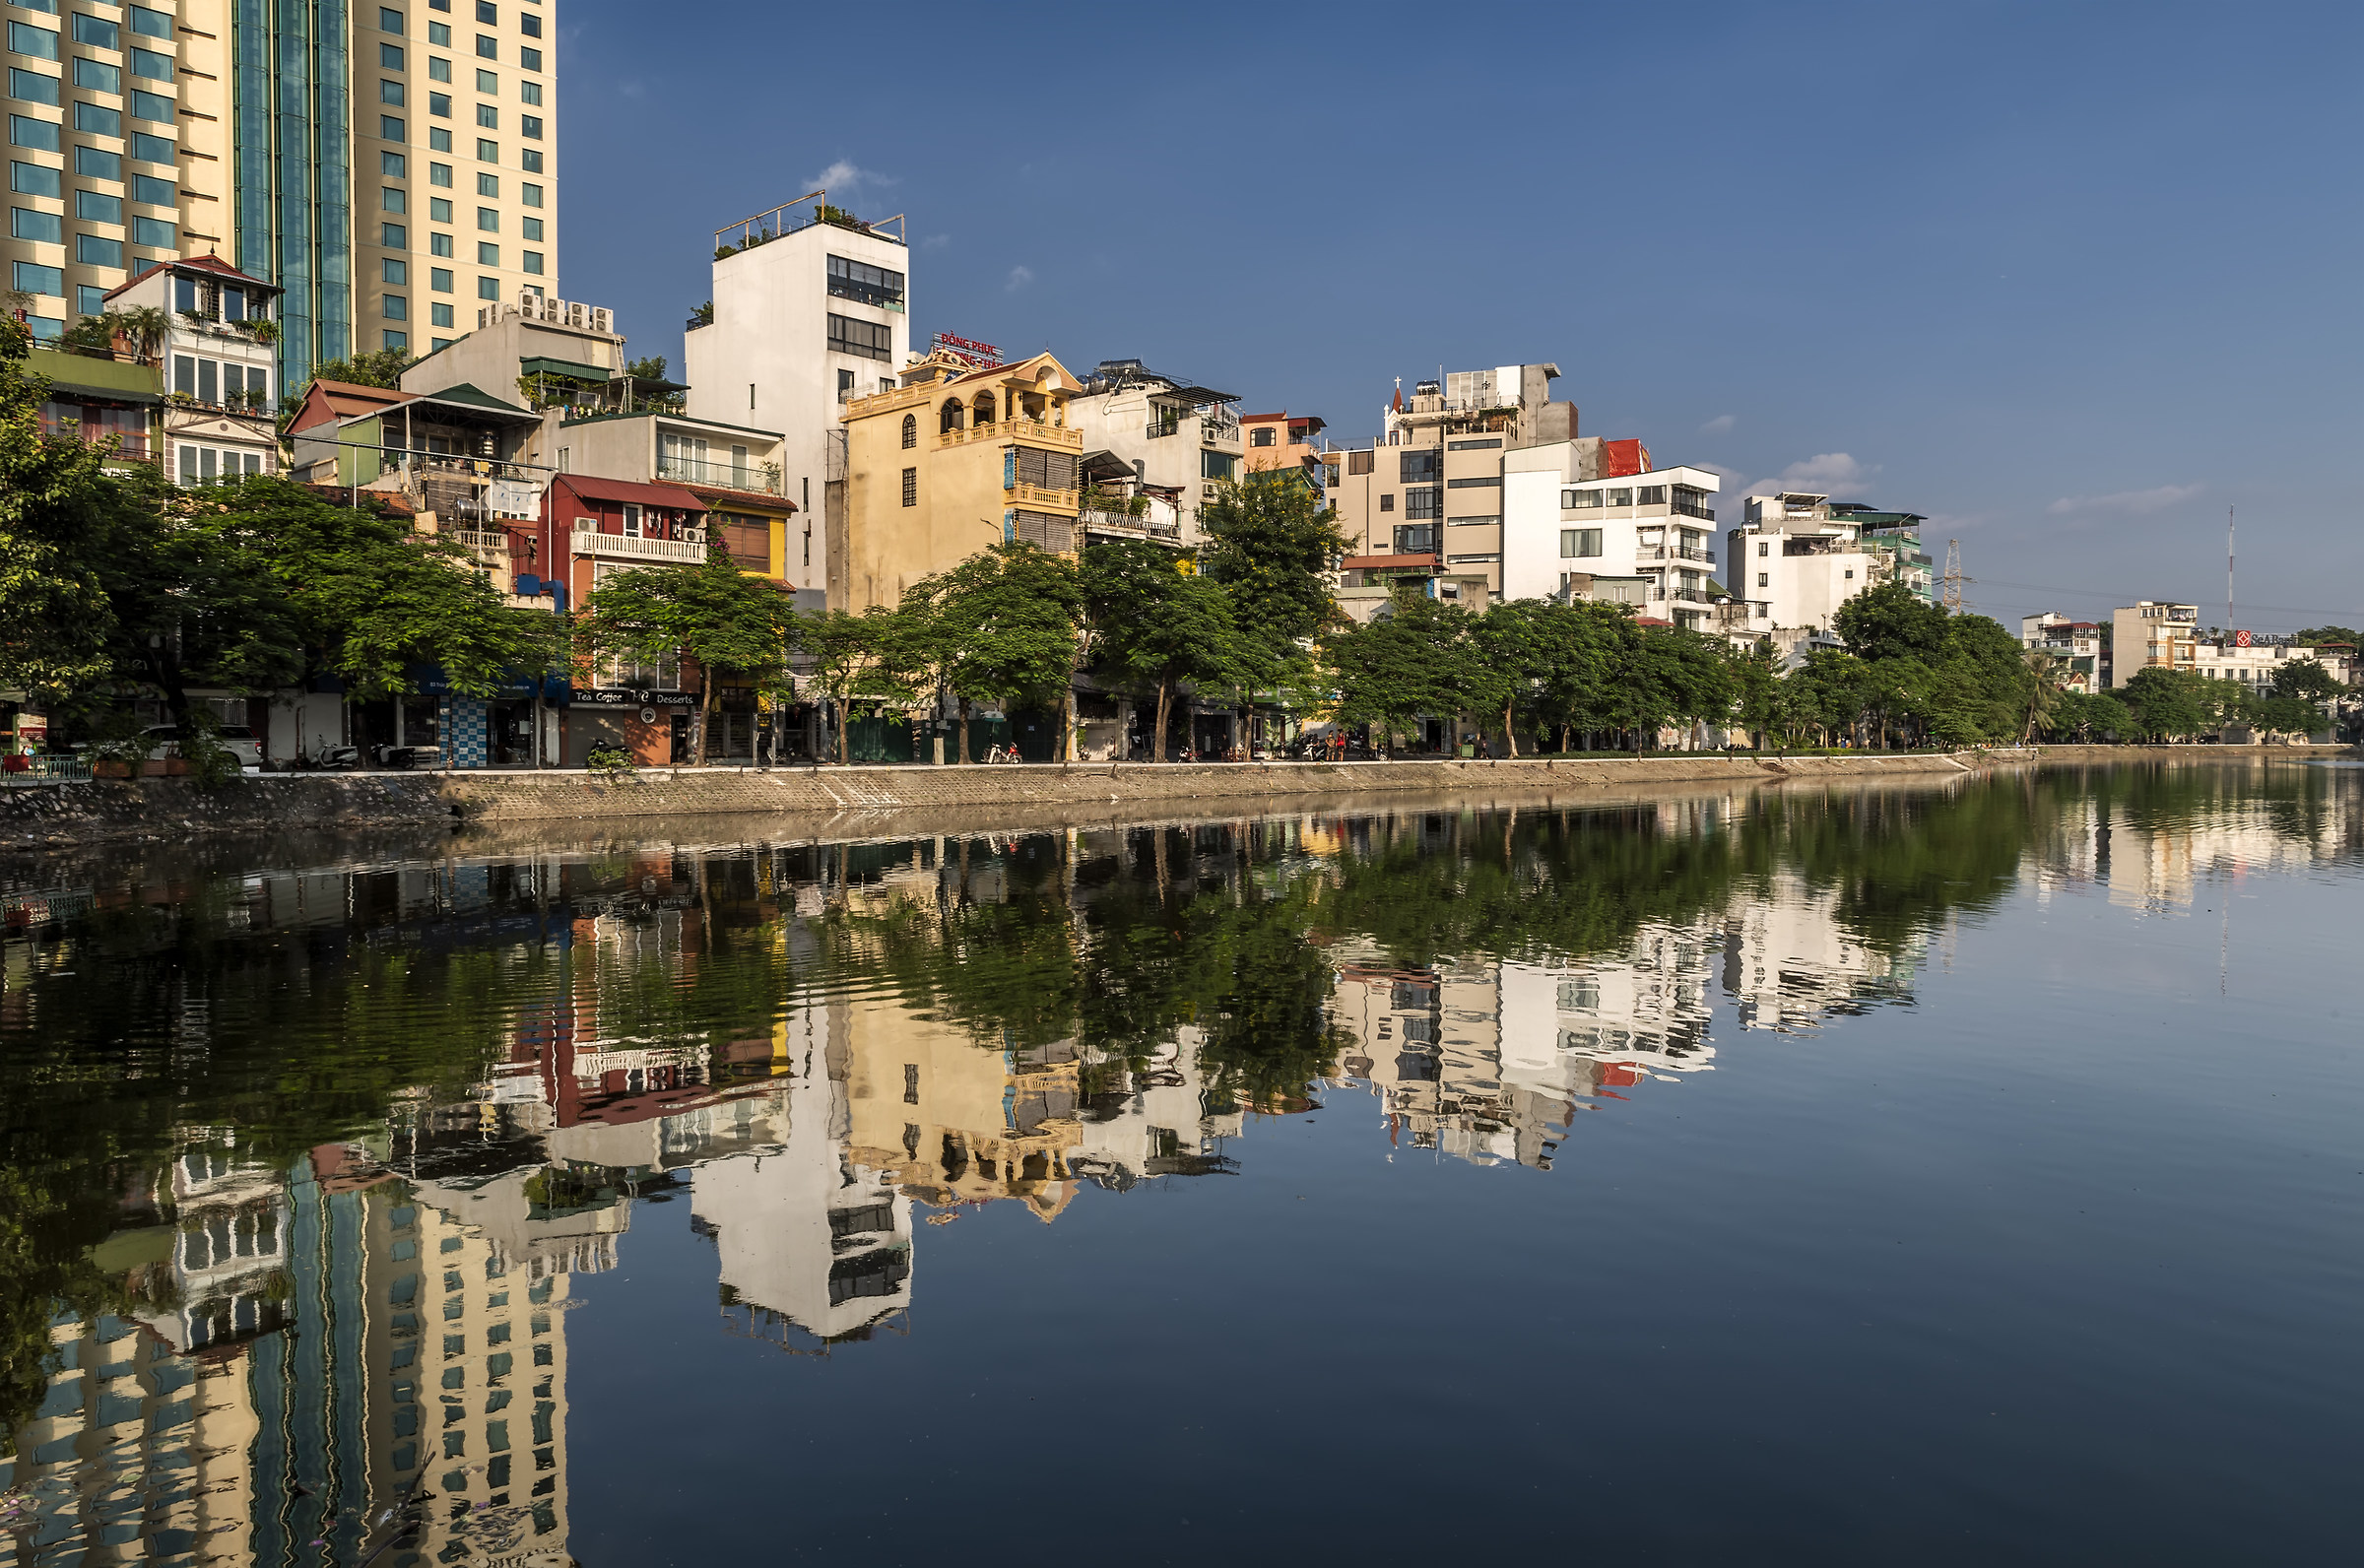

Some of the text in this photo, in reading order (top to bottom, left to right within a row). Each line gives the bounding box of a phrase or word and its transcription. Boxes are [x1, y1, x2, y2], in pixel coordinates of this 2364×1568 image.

[971, 340, 997, 357] PHỤC
[576, 691, 592, 701] Tea
[596, 691, 623, 703] Coffee
[657, 694, 693, 704] Desserts
